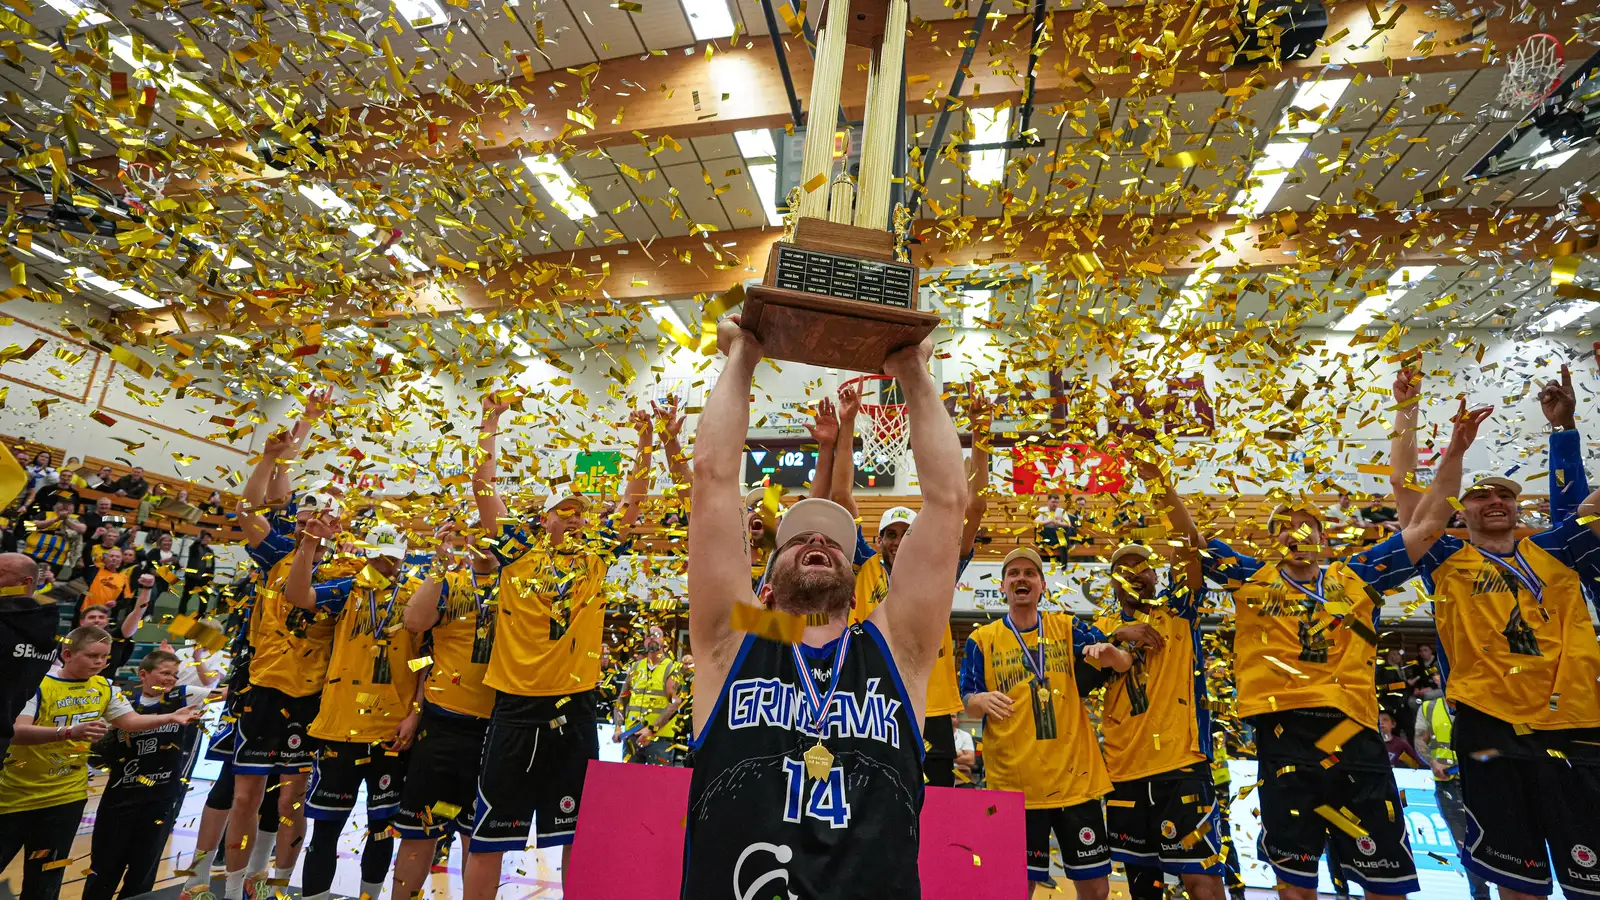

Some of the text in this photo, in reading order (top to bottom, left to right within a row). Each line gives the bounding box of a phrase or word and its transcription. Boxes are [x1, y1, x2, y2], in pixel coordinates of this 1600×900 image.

[778, 452, 804, 466] 102
[136, 738, 158, 756] 12
[122, 770, 172, 784] Einamar
[783, 756, 851, 829] 14
[554, 816, 578, 825] bus4
[1353, 858, 1400, 868] bus4u
[1494, 851, 1522, 864] Kæling
